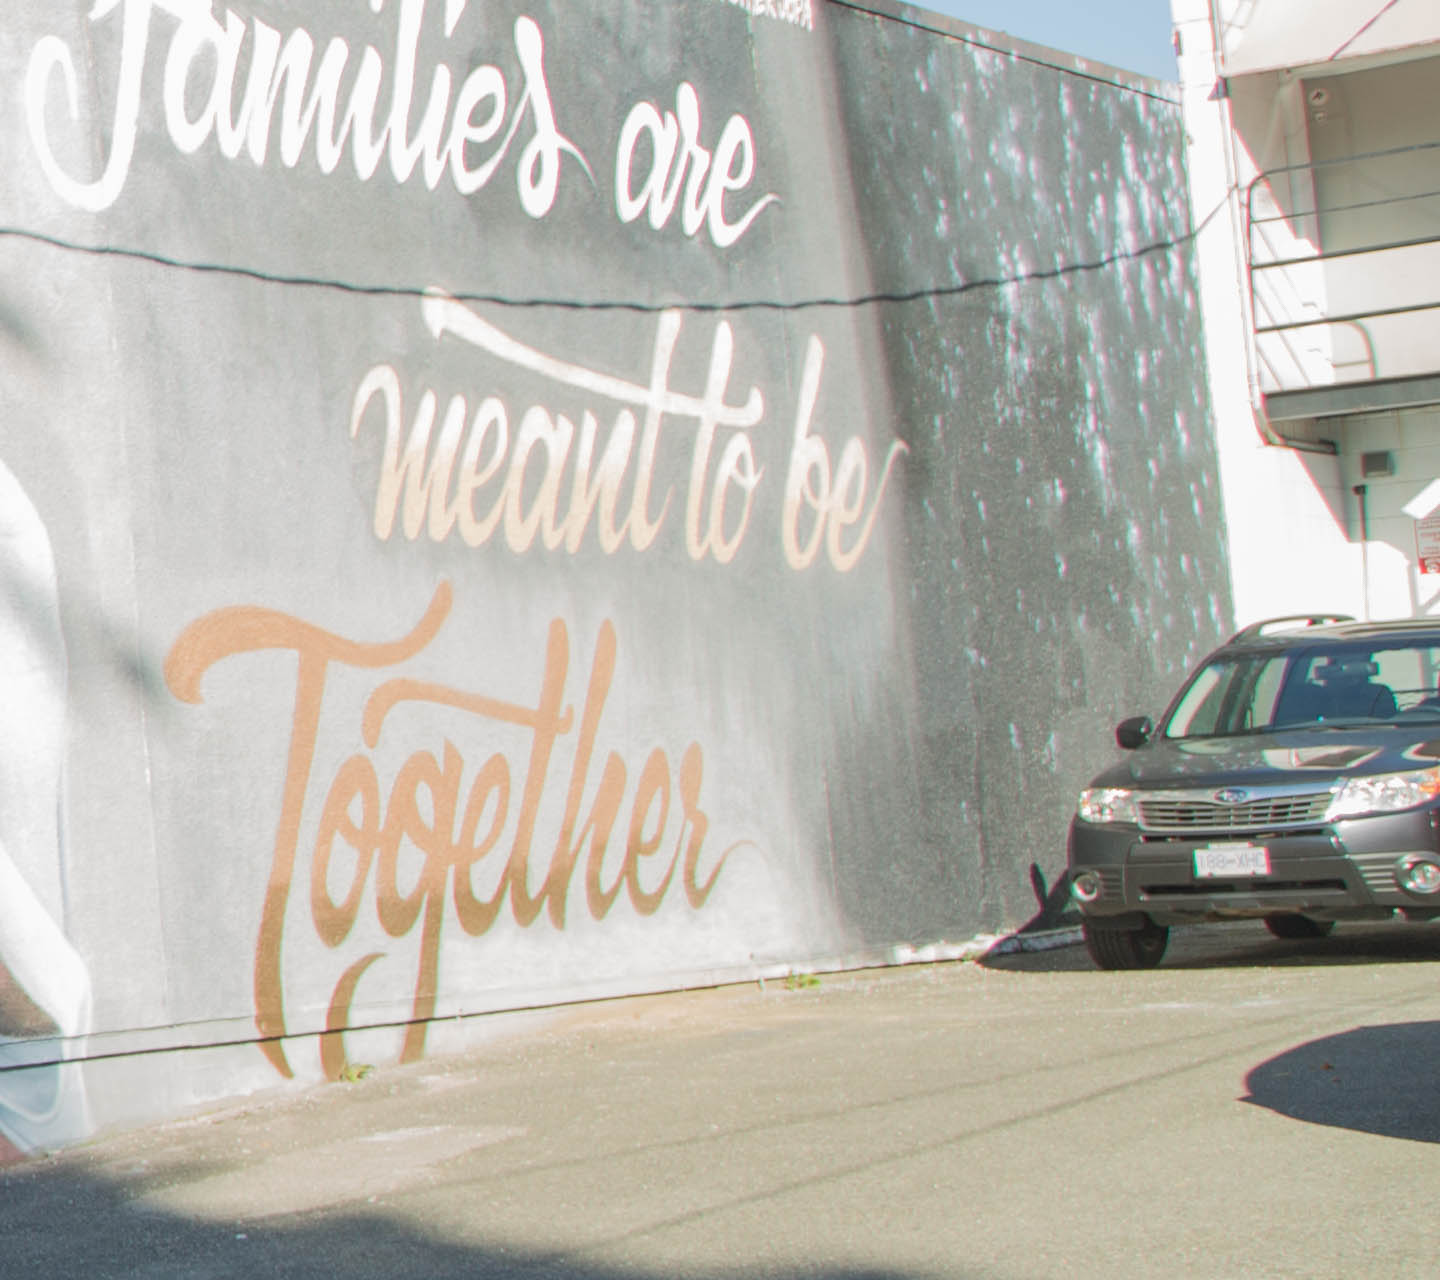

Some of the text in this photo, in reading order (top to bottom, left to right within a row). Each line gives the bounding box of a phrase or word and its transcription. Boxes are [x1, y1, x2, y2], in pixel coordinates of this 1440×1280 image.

[614, 82, 783, 248] are
[350, 286, 909, 572] meant to be
[163, 579, 770, 1082] Together
